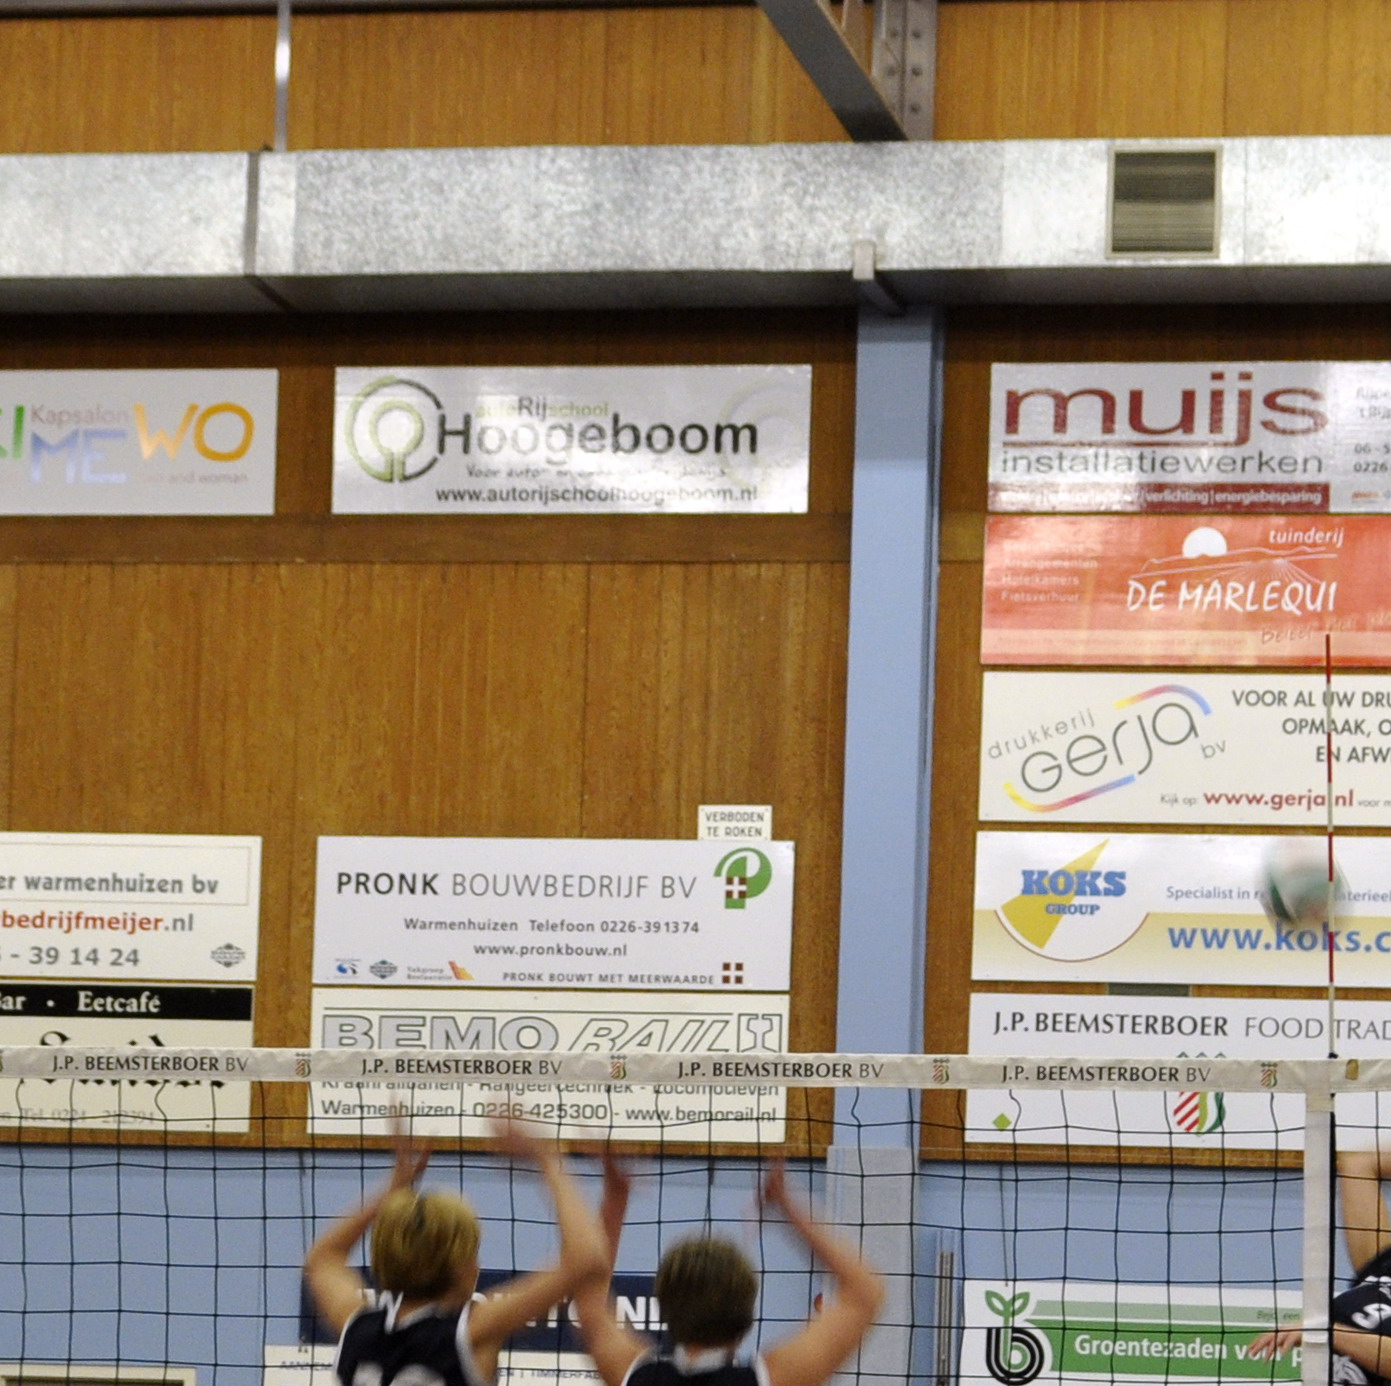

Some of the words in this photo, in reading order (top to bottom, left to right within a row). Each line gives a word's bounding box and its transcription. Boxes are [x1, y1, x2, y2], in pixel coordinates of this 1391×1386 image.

[31, 405, 129, 427] Kapsalon
[1004, 371, 1328, 447] muijs
[437, 412, 757, 466] Hoogeboom
[1003, 448, 1323, 474] installatiewerken
[1269, 528, 1344, 548] tuinderij
[1127, 580, 1167, 612] DE
[1178, 580, 1338, 616] MARLEQUI
[1232, 690, 1288, 708] VOOR
[1293, 690, 1316, 708] AL
[988, 708, 1096, 760] drukkerij
[1282, 719, 1372, 738] OPMAAK,
[1021, 702, 1199, 793] Gerja
[1316, 746, 1340, 763] EN
[706, 812, 764, 823] VERBODEN
[706, 826, 720, 837] TE
[726, 827, 762, 838] ROKEN
[25, 874, 183, 894] warmenhuizen
[191, 876, 219, 894] bv
[336, 872, 440, 896] PRONK
[452, 874, 650, 899] BOUWBEDRIJF
[661, 875, 697, 899] BV
[1021, 869, 1126, 898] KOKS
[1166, 886, 1234, 900] Specialist
[1045, 903, 1100, 916] GROUP
[404, 918, 518, 932] Warmenhuizen
[529, 919, 595, 933] Telefoon
[600, 919, 700, 935] 0226-391374
[29, 946, 60, 965] 39
[71, 947, 100, 966] 14
[109, 948, 140, 967] 24
[473, 943, 627, 957] www.pronkbouw.nl
[502, 972, 544, 983] PRONK
[549, 973, 594, 983] BOUWT
[599, 974, 624, 984] MET
[628, 974, 715, 985] MEERWAARDE
[78, 991, 160, 1012] Eetcafé
[322, 1014, 559, 1050] BEMO
[568, 1017, 732, 1053] RAIL
[994, 1011, 1029, 1036] J.P.
[1035, 1012, 1228, 1036] BEEMSTERBOER
[1245, 1016, 1323, 1039] FOOD
[84, 1054, 220, 1071] BEEMSTERBOER
[395, 1058, 533, 1075] BEEMSTERBOER
[711, 1060, 852, 1078] BEEMSTERBOER
[1036, 1064, 1179, 1083] BEEMSTERBOER
[321, 1100, 455, 1116] Warmenhuizen
[473, 1101, 608, 1120] 0226-425300
[626, 1107, 776, 1122] www.bemorail.nl
[1075, 1334, 1227, 1361] Groentezaden
